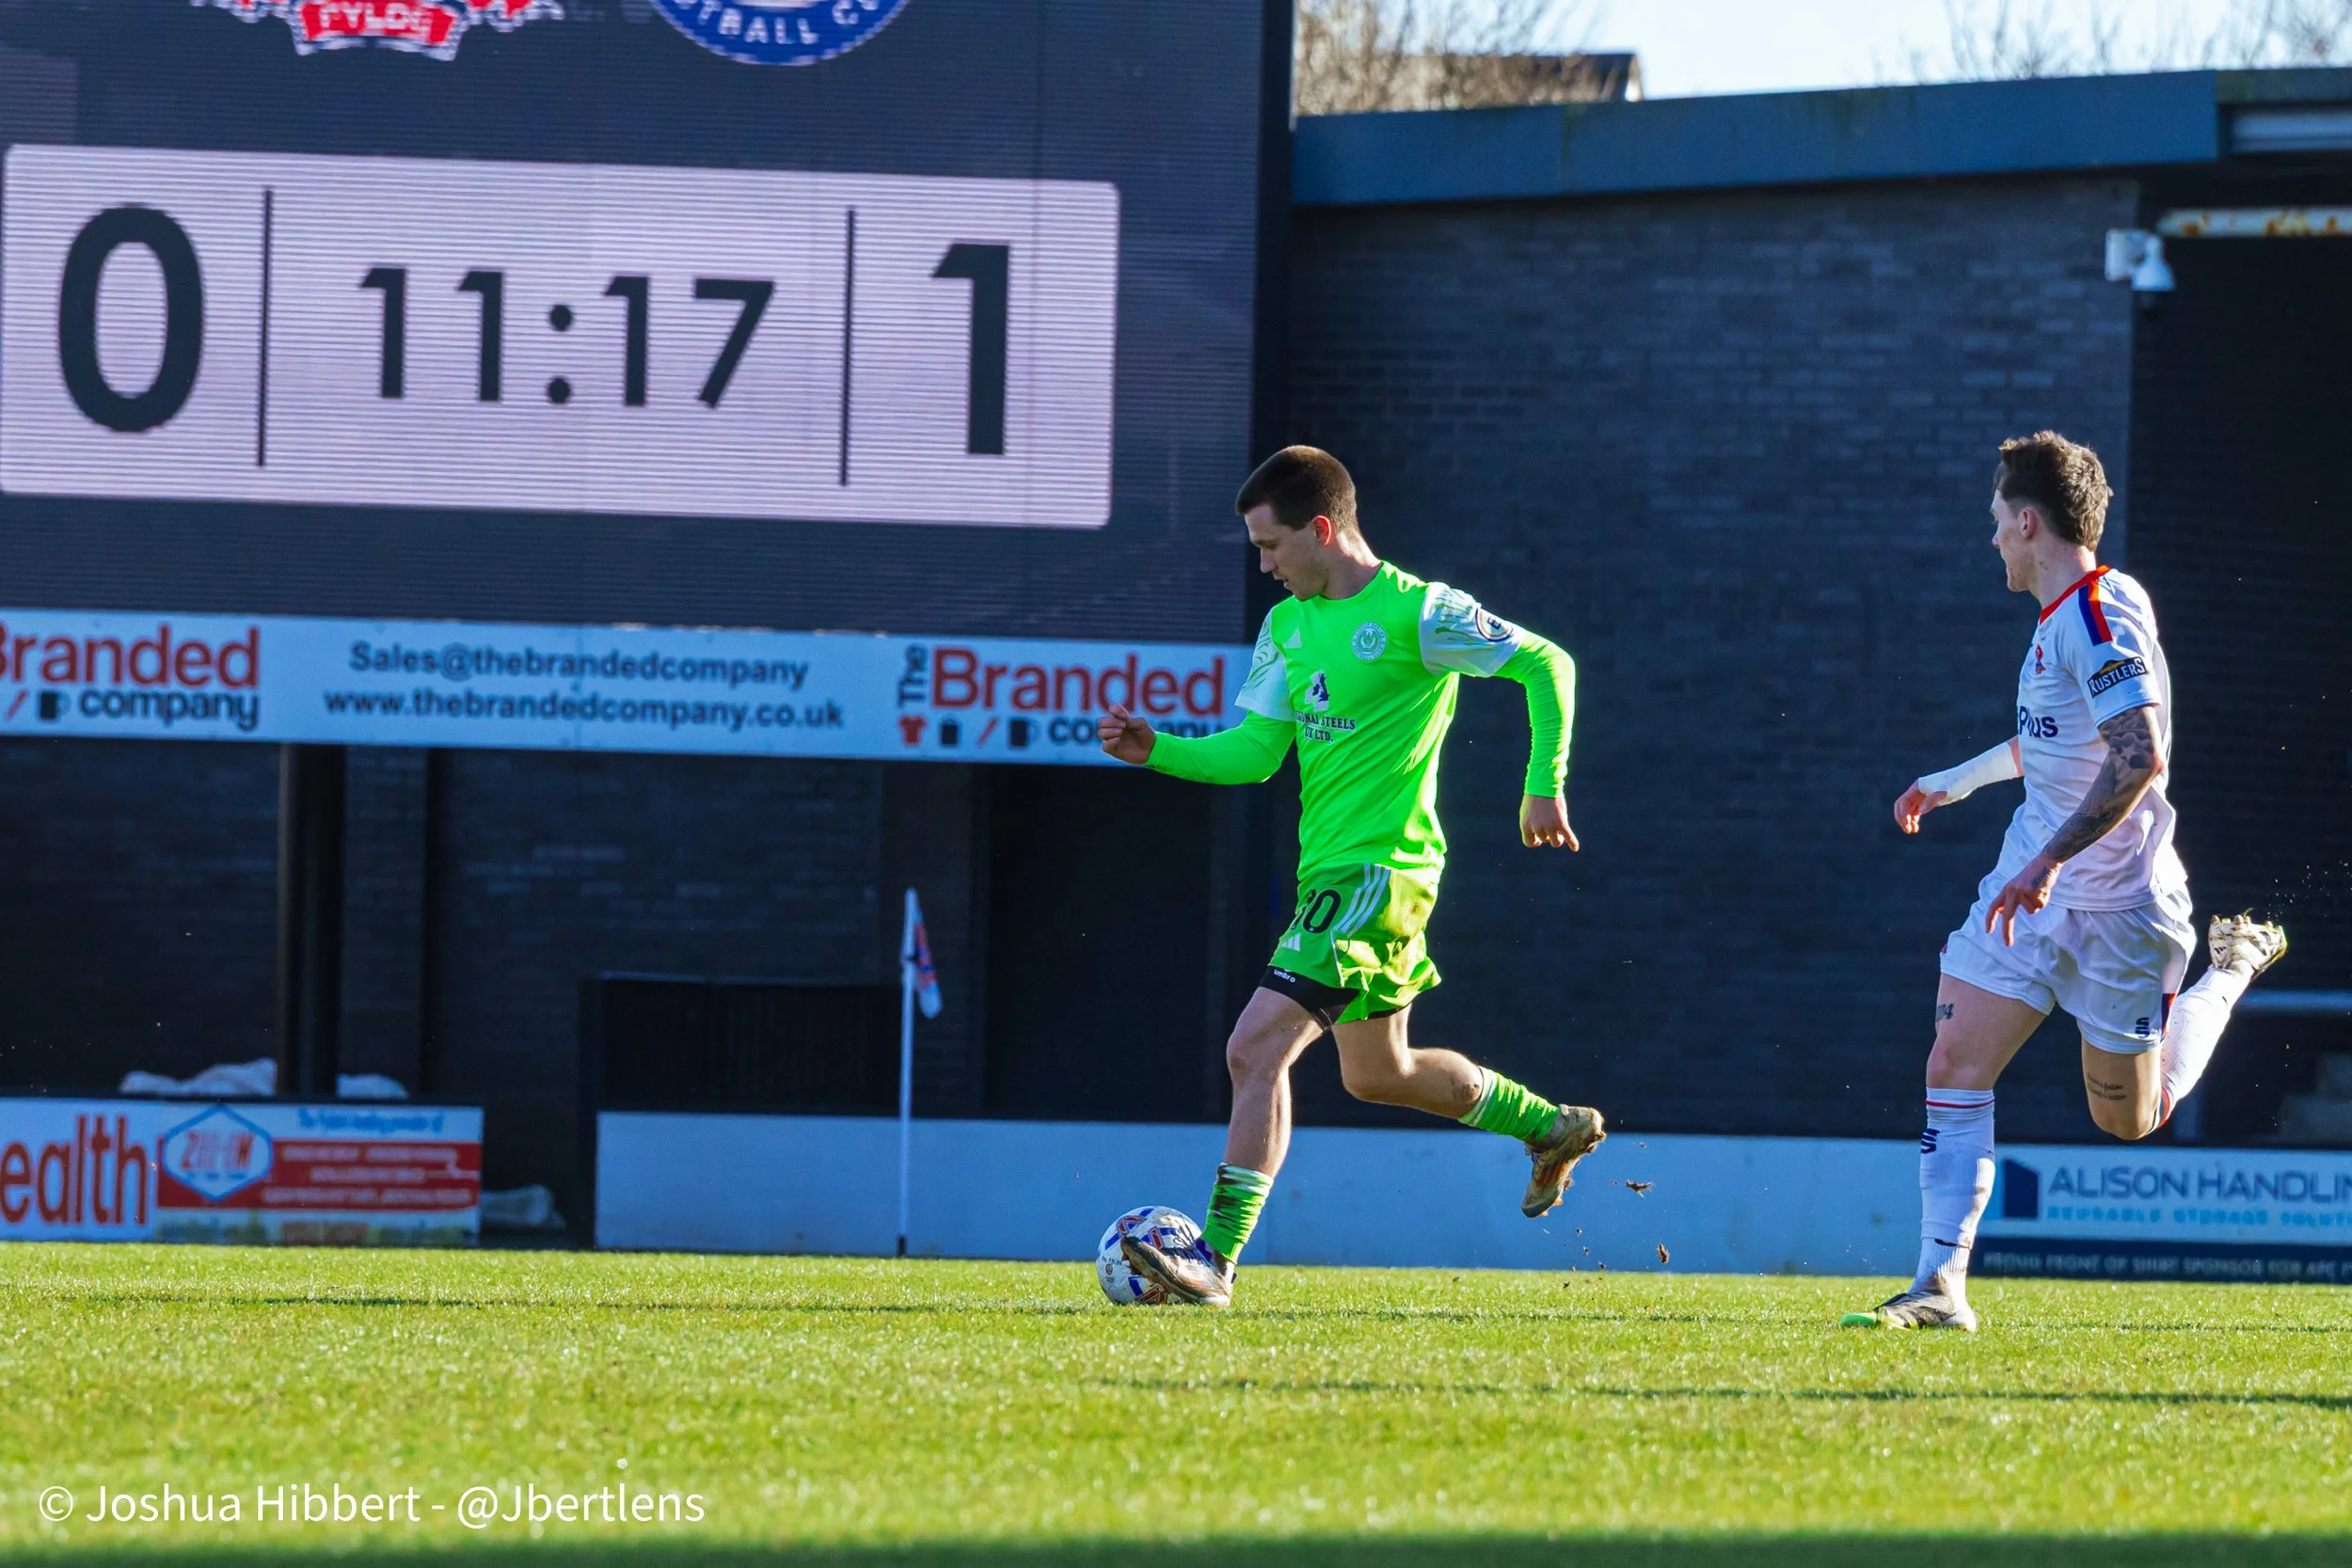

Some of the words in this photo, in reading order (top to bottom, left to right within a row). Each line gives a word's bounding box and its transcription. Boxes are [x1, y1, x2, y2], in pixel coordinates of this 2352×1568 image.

[58, 203, 203, 432] 0
[358, 267, 775, 408] 11:17
[930, 243, 1009, 455] 1
[349, 640, 808, 689] Sales@thebrandedcompany
[932, 647, 1225, 718] Branded
[2089, 658, 2145, 696] RUSTLERS
[79, 689, 259, 730] company
[324, 689, 843, 732] www.thebrandedcompany.co.uk
[1321, 715, 1355, 730] STEELS
[2048, 1164, 2190, 1199] ALISON
